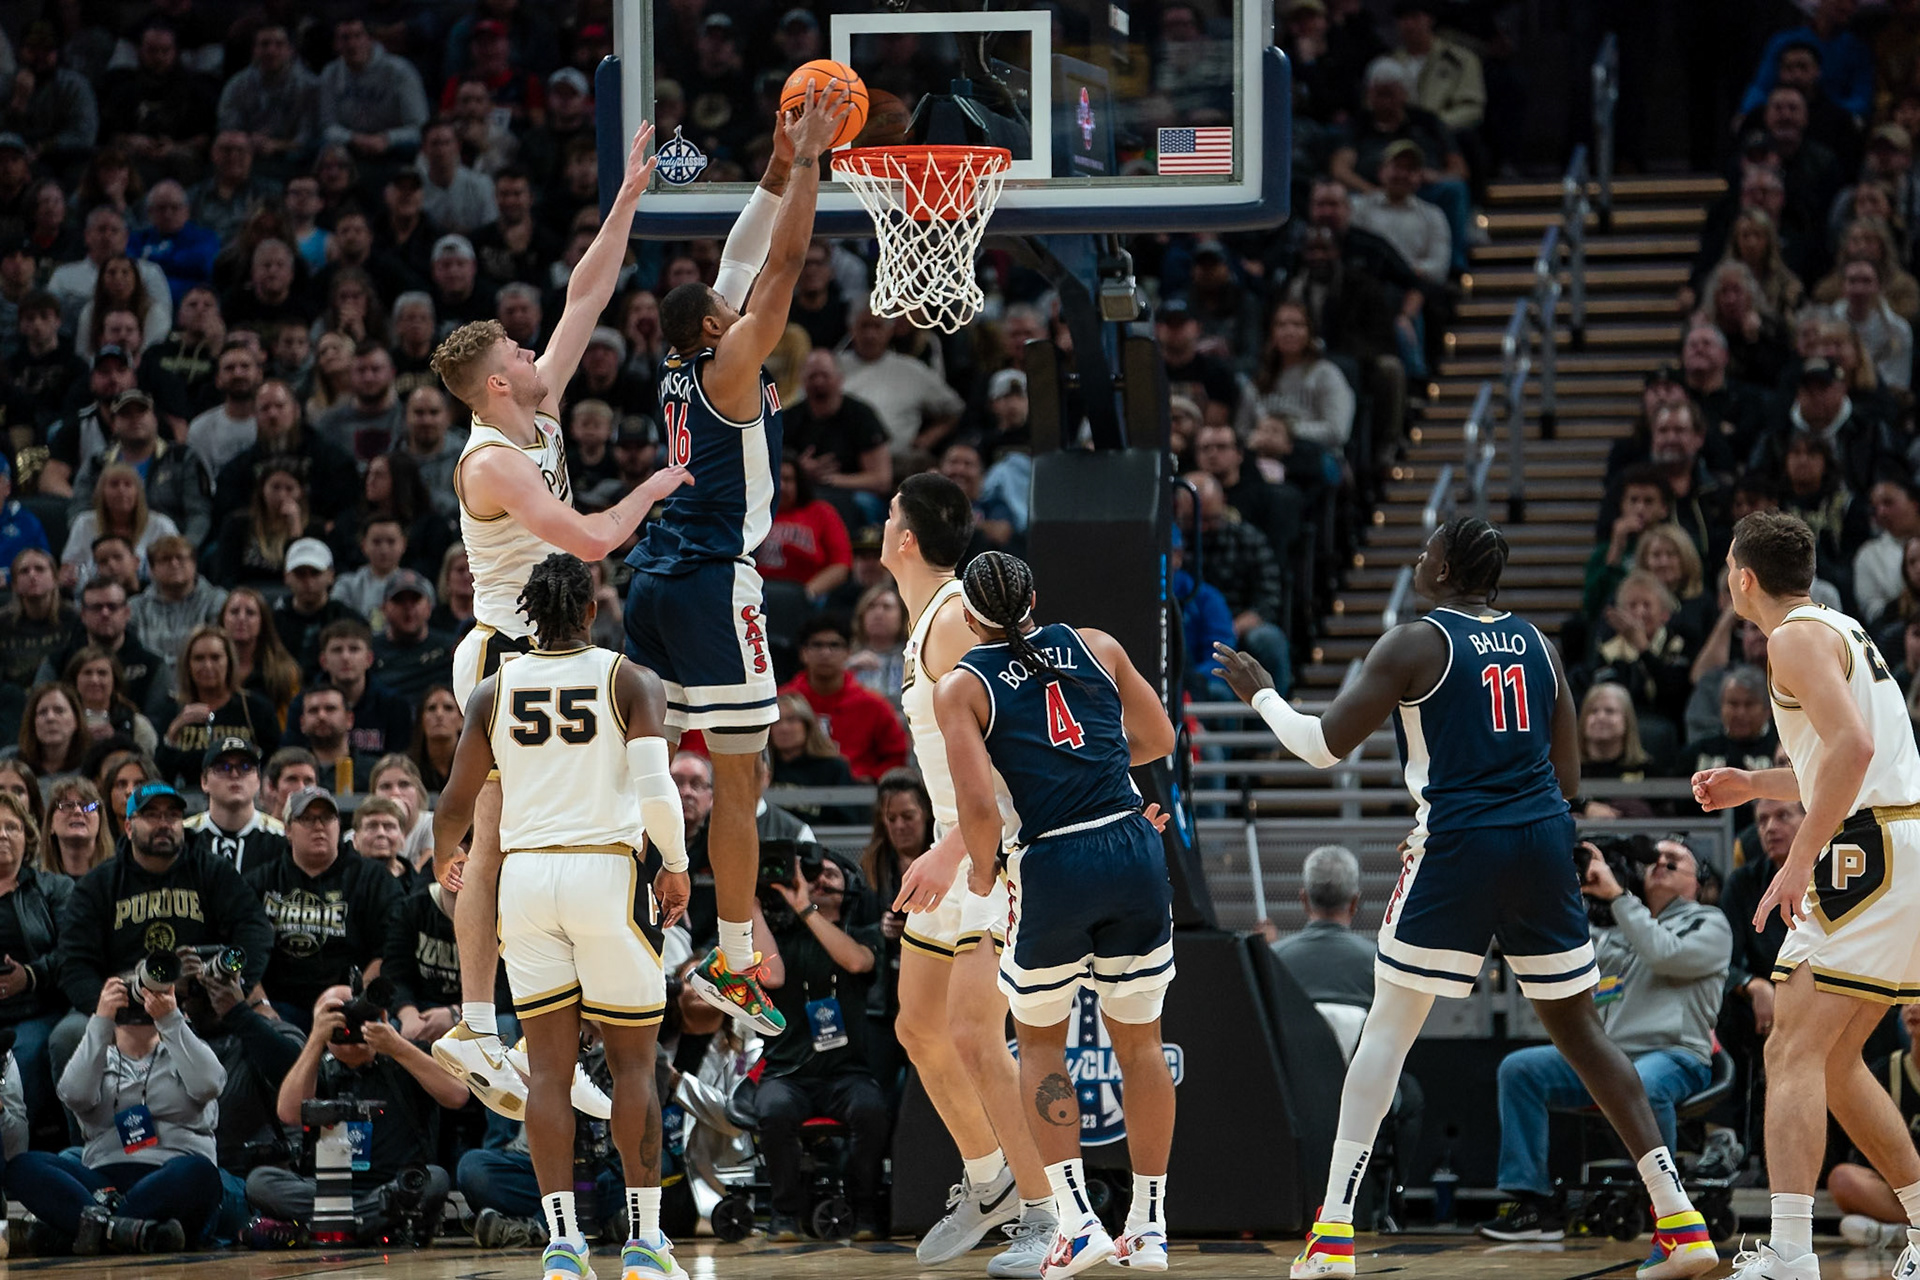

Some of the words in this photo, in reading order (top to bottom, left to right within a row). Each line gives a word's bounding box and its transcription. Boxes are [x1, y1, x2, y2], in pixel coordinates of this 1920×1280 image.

[664, 401, 691, 468] 16
[741, 604, 768, 674] CATS
[998, 646, 1078, 690] BOELL
[1468, 631, 1526, 656] BALLO
[1848, 627, 1890, 683] 2
[509, 685, 598, 747] 55
[1045, 680, 1086, 750] 4
[1481, 663, 1530, 732] 11
[1831, 843, 1867, 890] P
[114, 887, 205, 931] PURDUE
